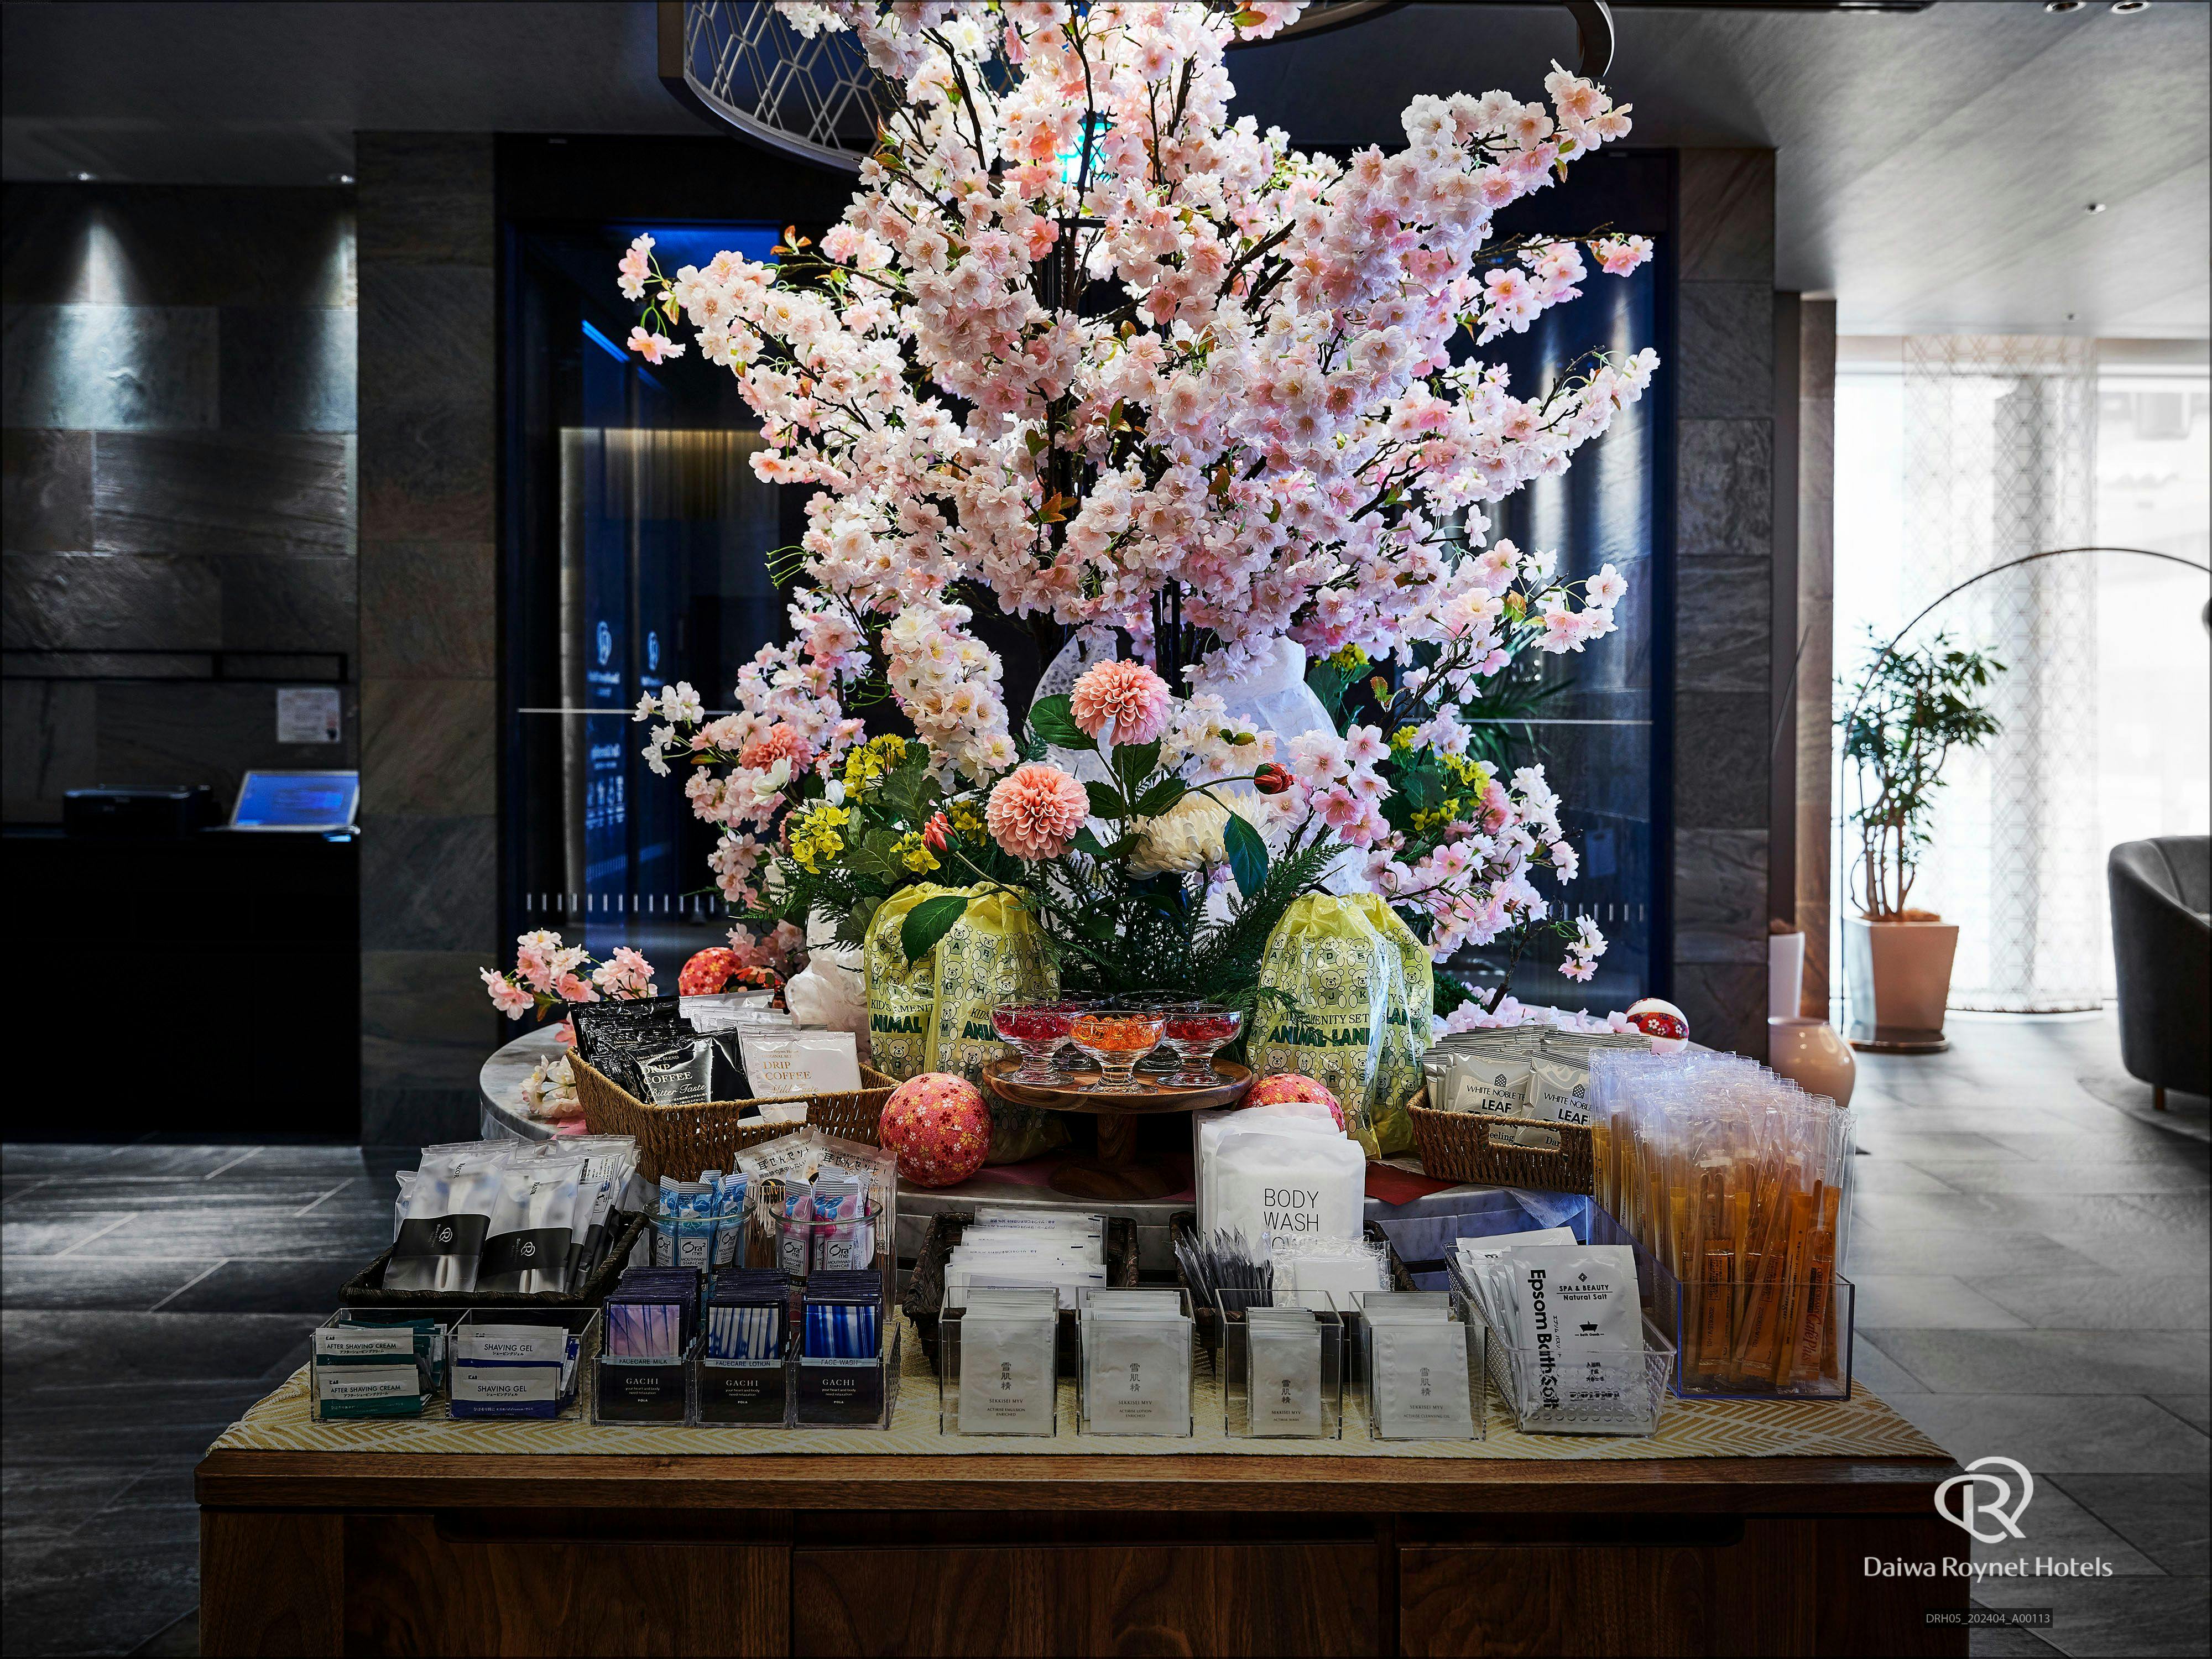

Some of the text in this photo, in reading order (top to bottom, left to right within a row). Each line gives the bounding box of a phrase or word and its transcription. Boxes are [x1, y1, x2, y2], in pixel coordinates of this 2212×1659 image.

[977, 986, 984, 994] H
[893, 1004, 935, 1014] AMENIT
[870, 1014, 922, 1034] NIMAL
[1349, 1014, 1370, 1024] SET
[640, 1063, 671, 1075] DRIP
[764, 1071, 812, 1081] COFFEE
[643, 1071, 693, 1085] COFFEE
[646, 1083, 707, 1098] Bitter Taste
[1467, 1085, 1526, 1103] WHITE NOBLE TE
[1543, 1092, 1568, 1105] WHITE
[1481, 1098, 1512, 1114] LEAF
[1557, 1108, 1589, 1125] LEAF
[1489, 1130, 1515, 1143] eeling
[453, 1162, 466, 1179] RAZOR
[1264, 1188, 1319, 1209] BODY
[1264, 1211, 1319, 1232] WASH
[1527, 1269, 1548, 1330] Epsom
[484, 1343, 518, 1352] SHAVING
[1000, 1362, 1012, 1391] 雪肌精
[1129, 1363, 1140, 1392] 雪肌精
[1420, 1367, 1431, 1397] 雪肌精
[1281, 1379, 1291, 1404] 雪肌精
